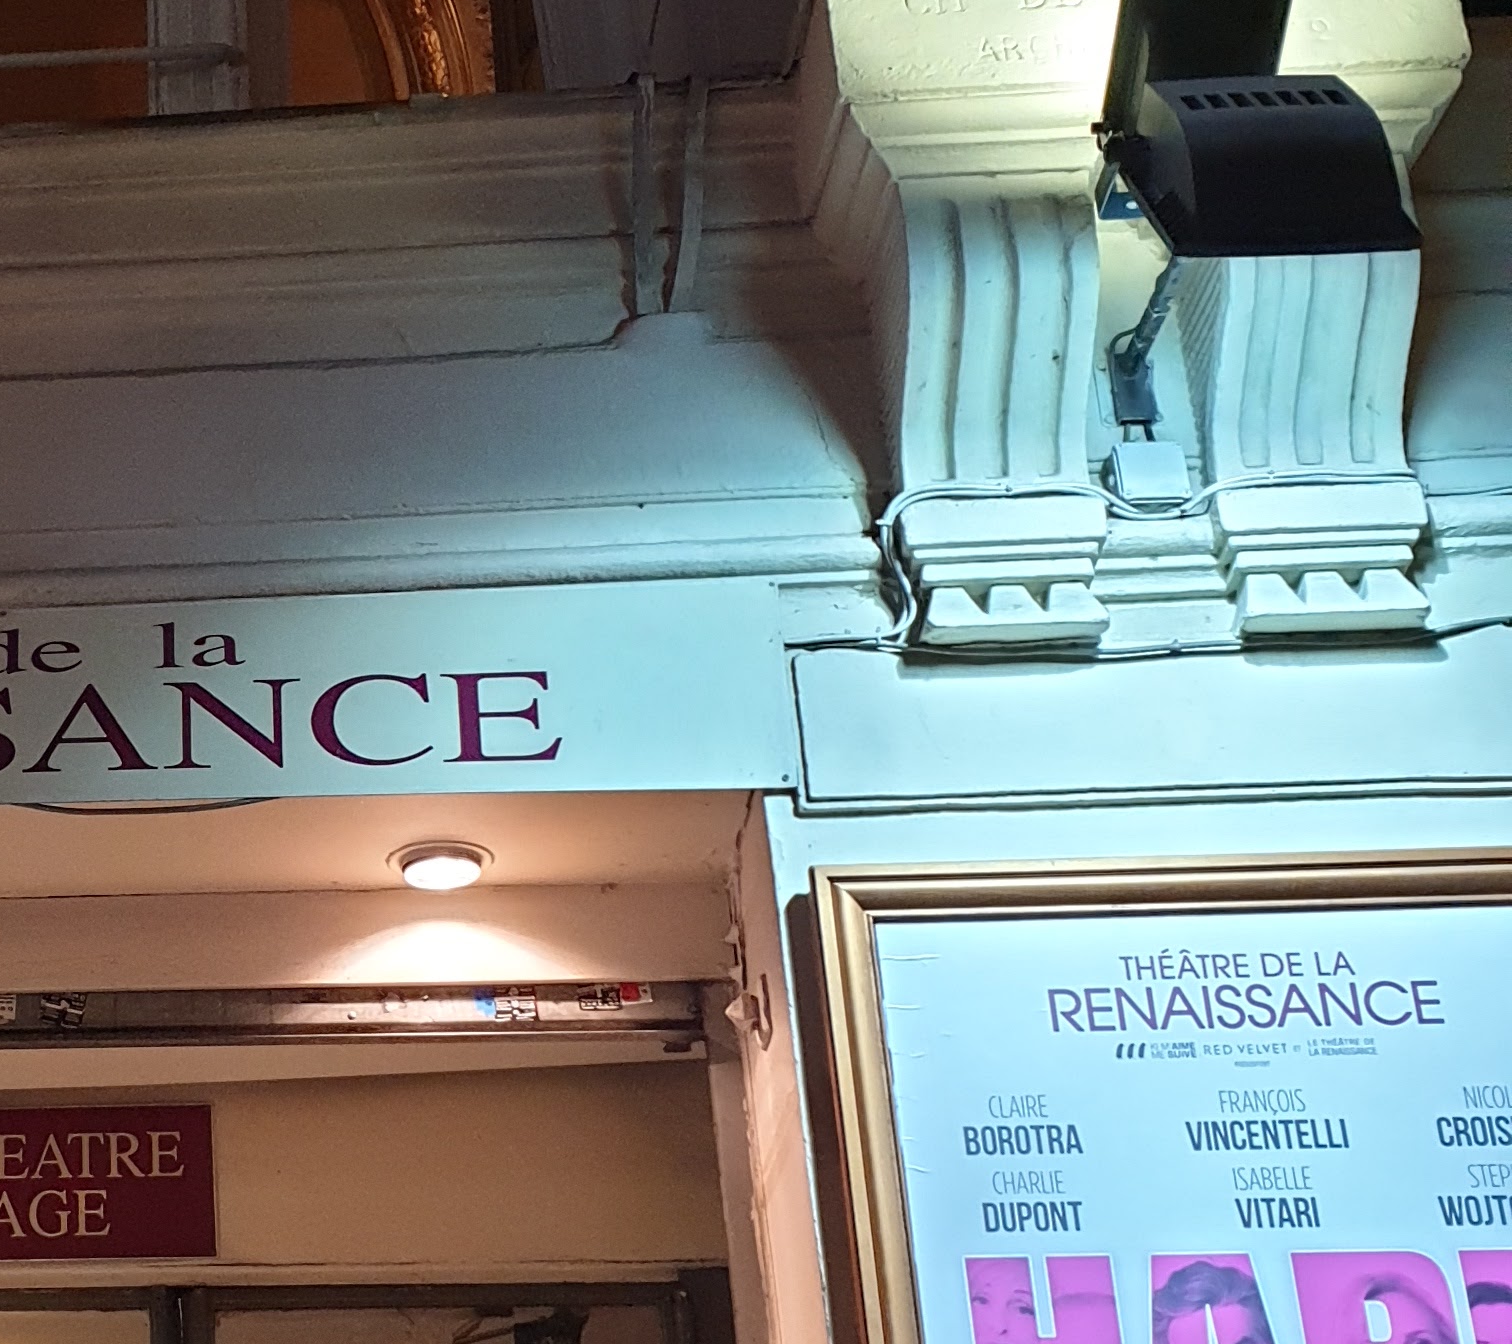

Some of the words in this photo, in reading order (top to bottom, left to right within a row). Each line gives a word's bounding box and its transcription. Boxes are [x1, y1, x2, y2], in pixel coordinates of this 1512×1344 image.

[155, 620, 246, 671] la
[1118, 948, 1251, 982] THÉÂTRE
[1260, 951, 1305, 978] DE
[1314, 949, 1356, 976] LA
[1046, 979, 1446, 1033] RENAISSANCE
[1203, 1044, 1234, 1056] RED
[1237, 1042, 1289, 1055] VELVET
[988, 1094, 1050, 1119] CLAIRE
[1218, 1088, 1307, 1116] FRANÇOIS
[962, 1123, 1084, 1156] BOROTRA
[1184, 1118, 1351, 1152] VINCENTELLI
[1436, 1115, 1512, 1147] CROIS
[991, 1169, 1066, 1195] CHARLIE
[1231, 1165, 1314, 1191] ISABELLE
[981, 1201, 1083, 1233] DUPONT
[1234, 1196, 1322, 1228] VITARI
[1437, 1195, 1512, 1227] WOJT
